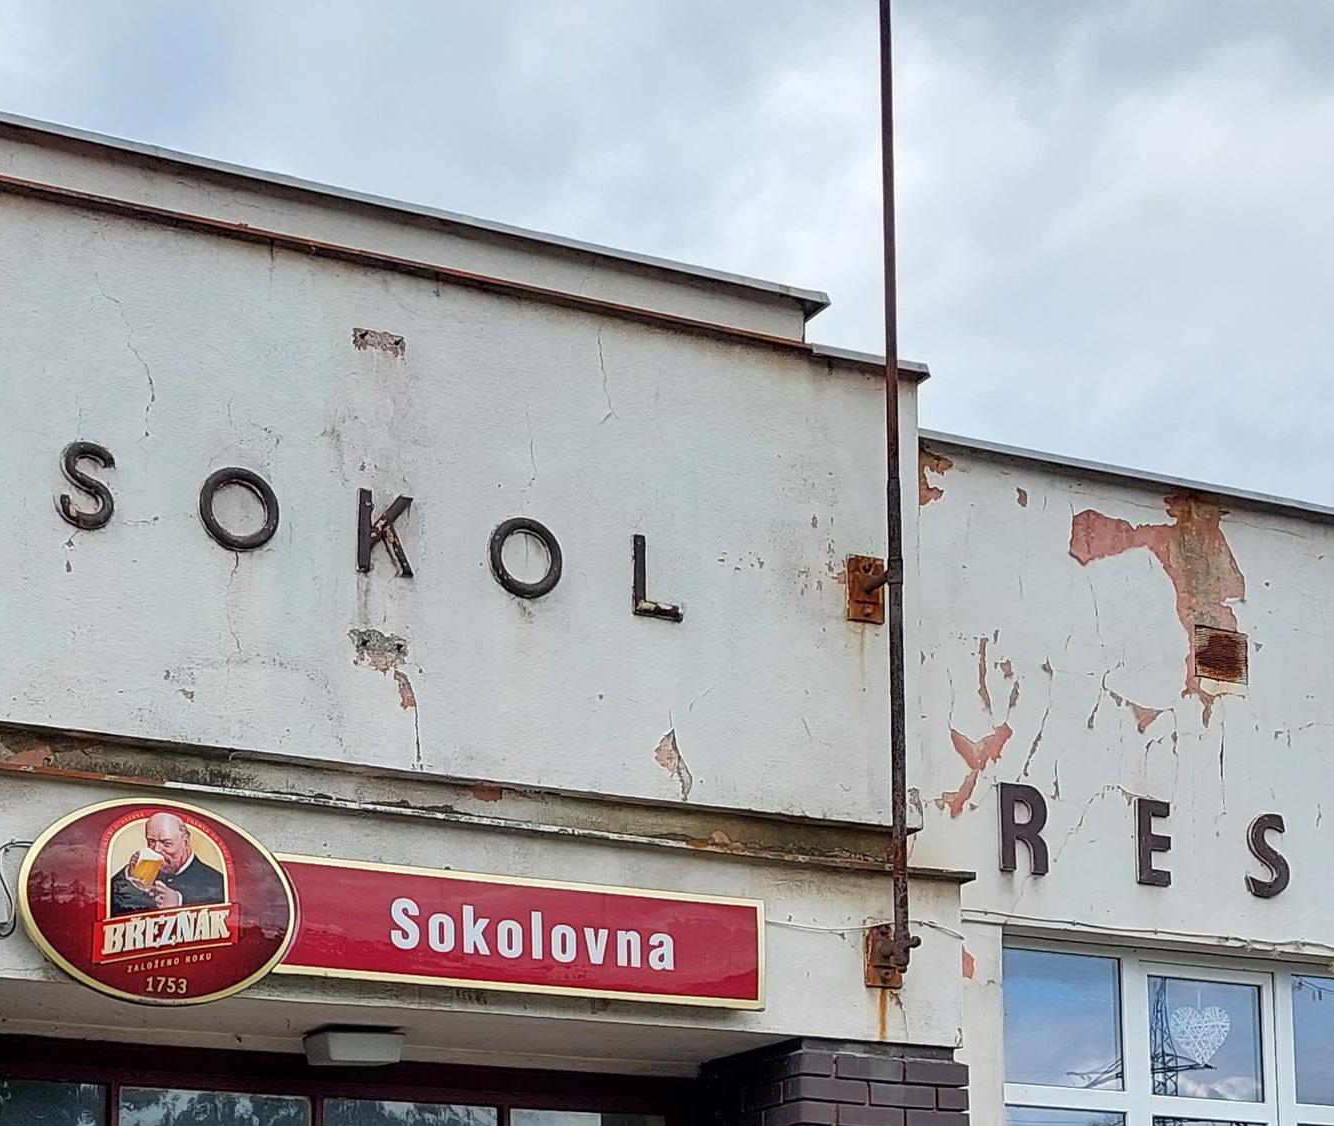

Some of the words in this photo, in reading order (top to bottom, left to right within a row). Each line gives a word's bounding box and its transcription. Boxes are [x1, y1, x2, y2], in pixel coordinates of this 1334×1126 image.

[55, 441, 683, 622] SOKOL
[100, 907, 230, 955] BŘEZŇÁK
[389, 896, 676, 972] Sokolovna
[126, 957, 180, 974] ZALOŽENO
[185, 952, 212, 964] ROKU
[145, 975, 188, 994] 1753
